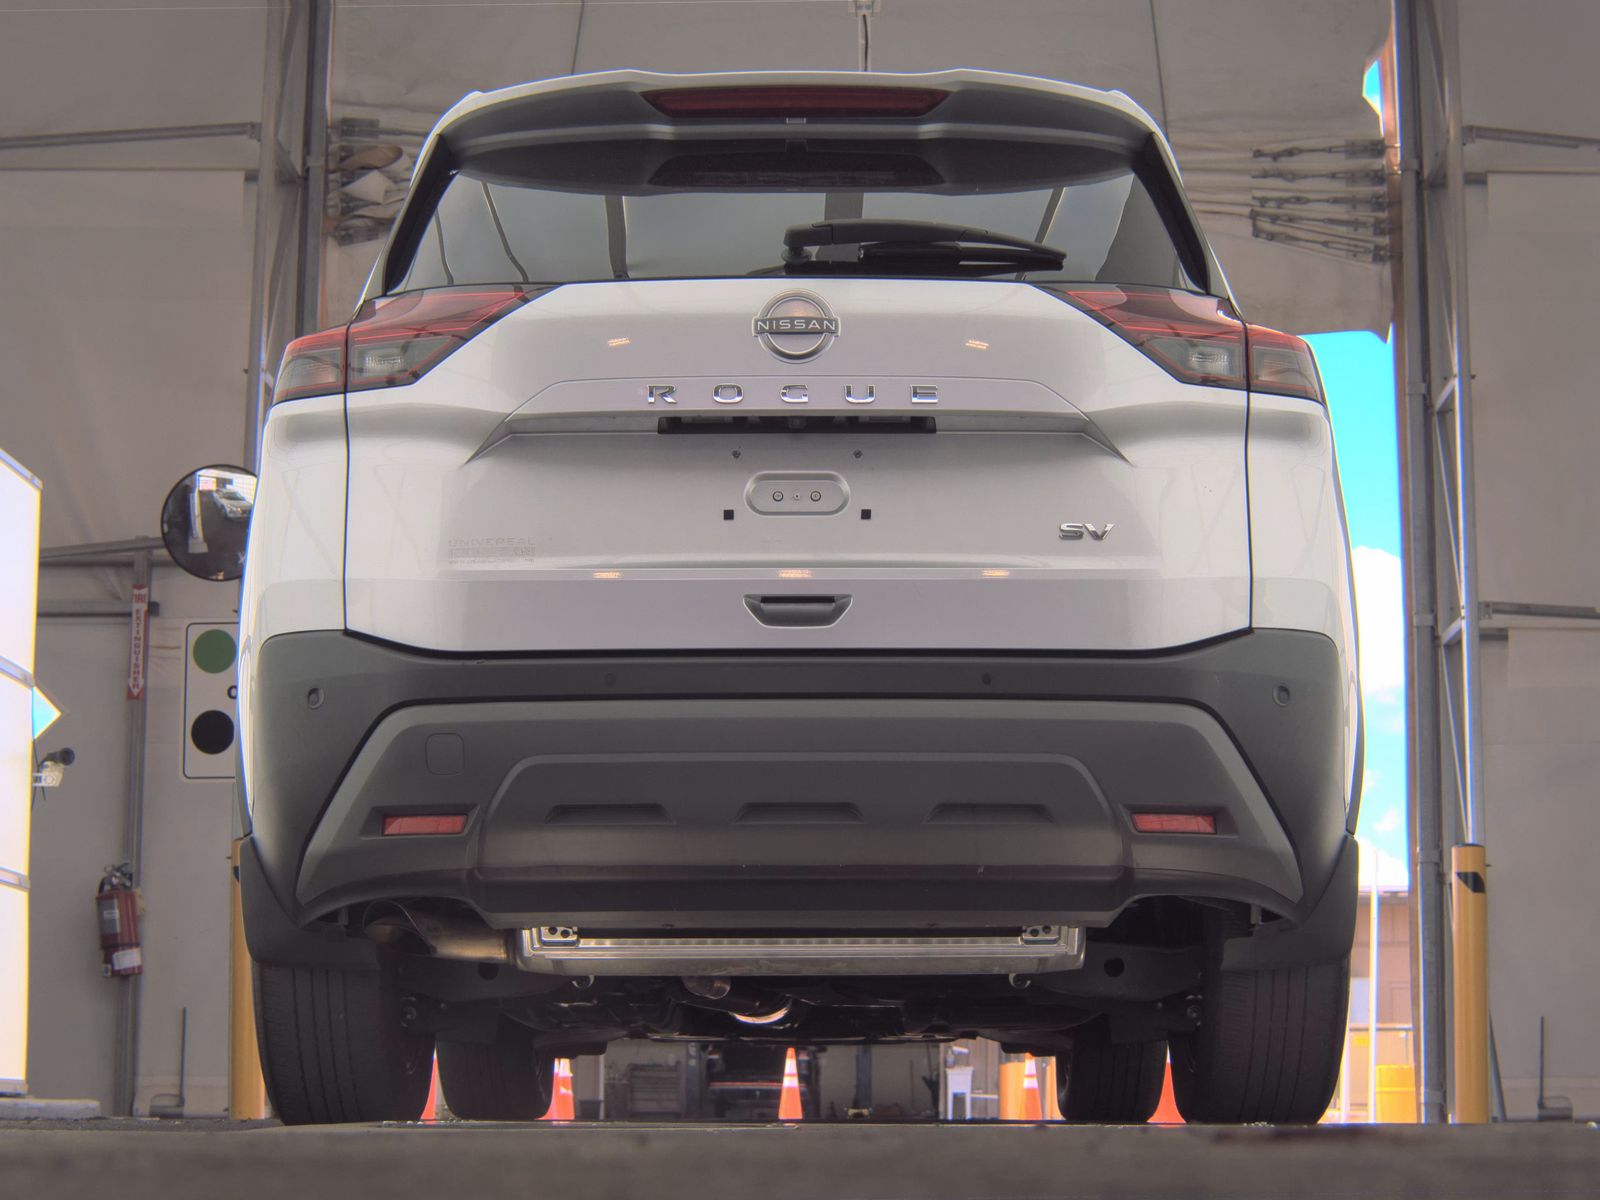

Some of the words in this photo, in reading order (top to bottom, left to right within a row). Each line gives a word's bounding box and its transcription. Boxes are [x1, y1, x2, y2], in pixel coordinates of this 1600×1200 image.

[757, 319, 836, 331] NISSAN
[647, 383, 938, 404] ROGUE
[1059, 523, 1115, 541] SV
[132, 608, 142, 689] EXTINGUISHER
